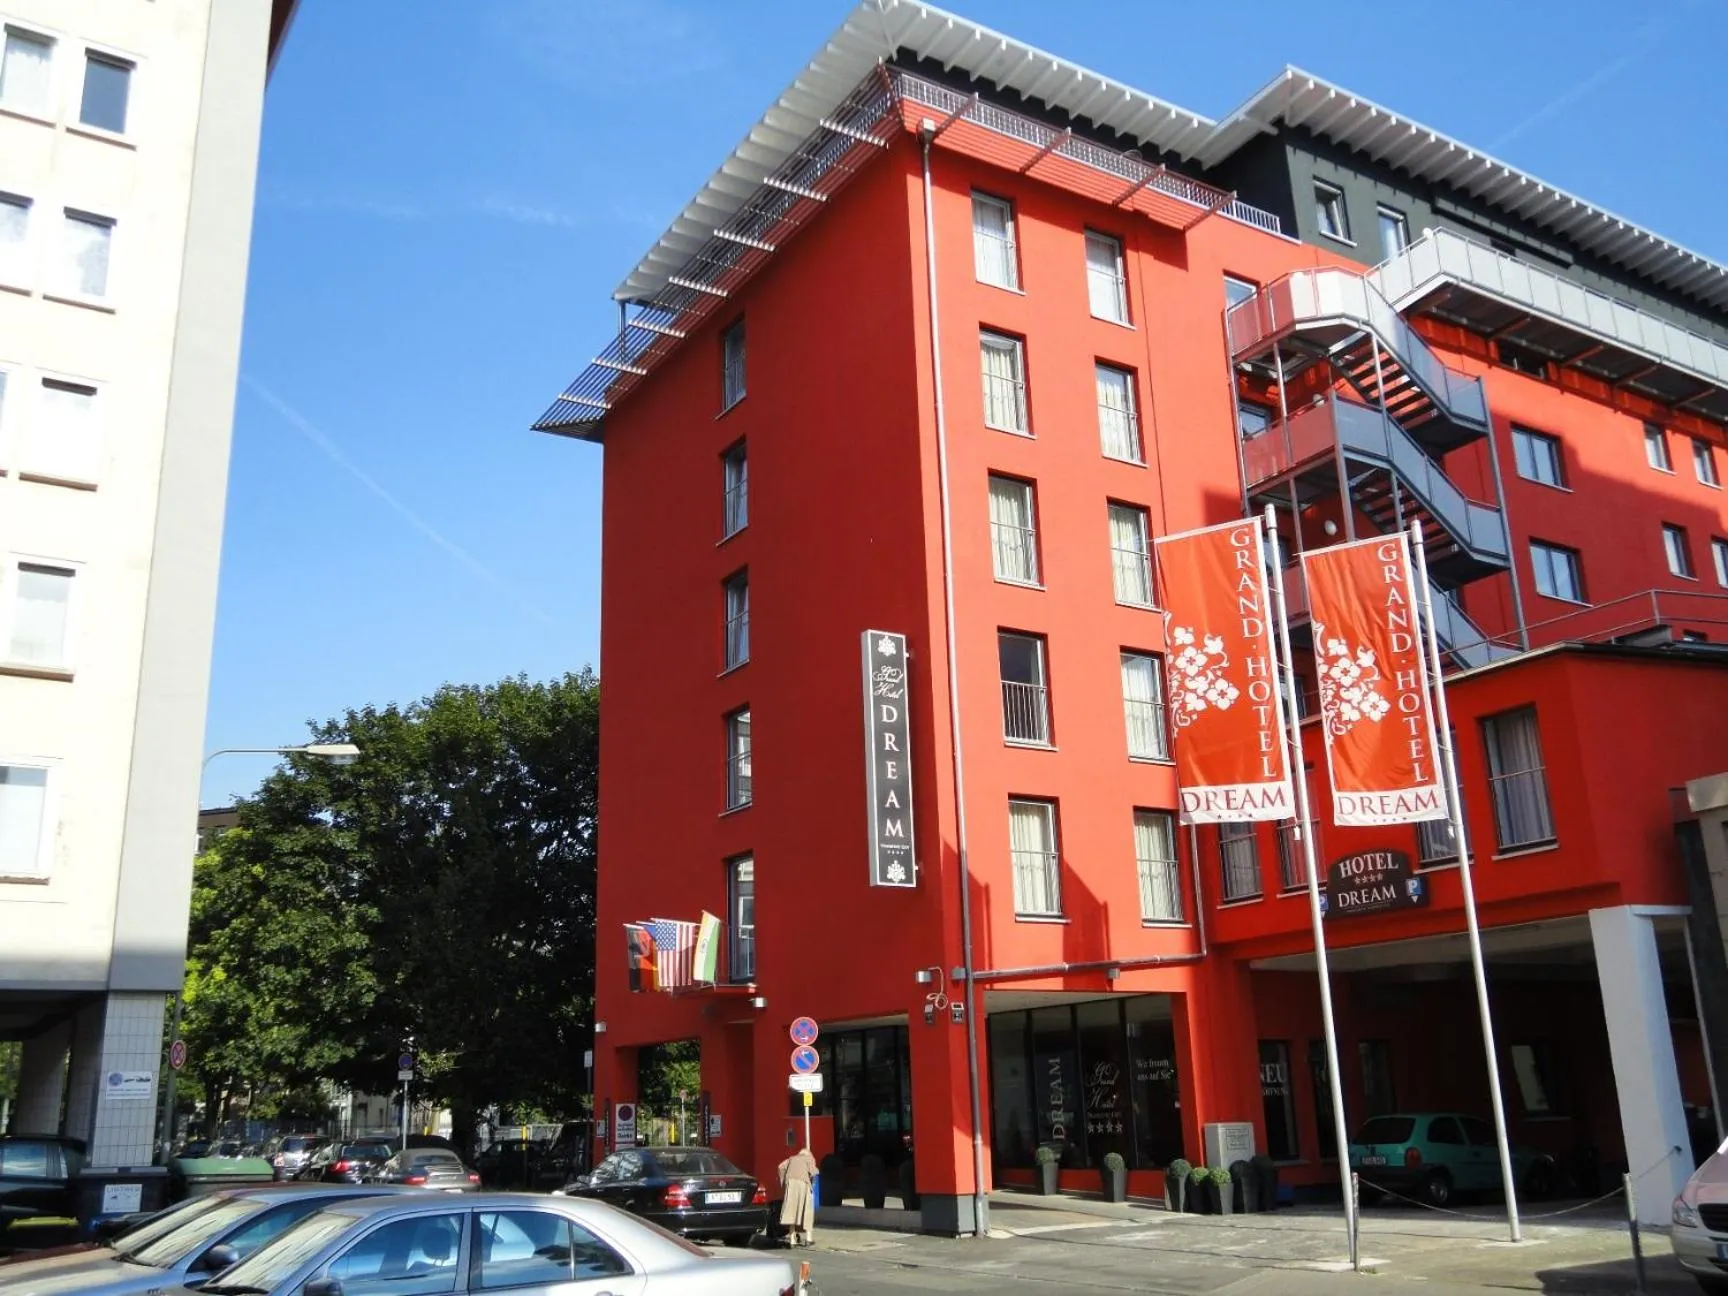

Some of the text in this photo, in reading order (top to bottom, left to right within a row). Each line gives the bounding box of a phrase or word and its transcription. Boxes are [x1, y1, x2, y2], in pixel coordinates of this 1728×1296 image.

[1230, 527, 1277, 778] GRAND HOTEL
[1377, 543, 1428, 783] GRAND HOTEL
[881, 704, 905, 839] DREAM
[1180, 784, 1286, 813] DREAM
[1337, 789, 1439, 816] DREAM
[1338, 852, 1399, 879] HOTEL
[1337, 884, 1397, 908] DREAM
[1408, 879, 1418, 894] P
[1048, 1056, 1063, 1140] DREAM
